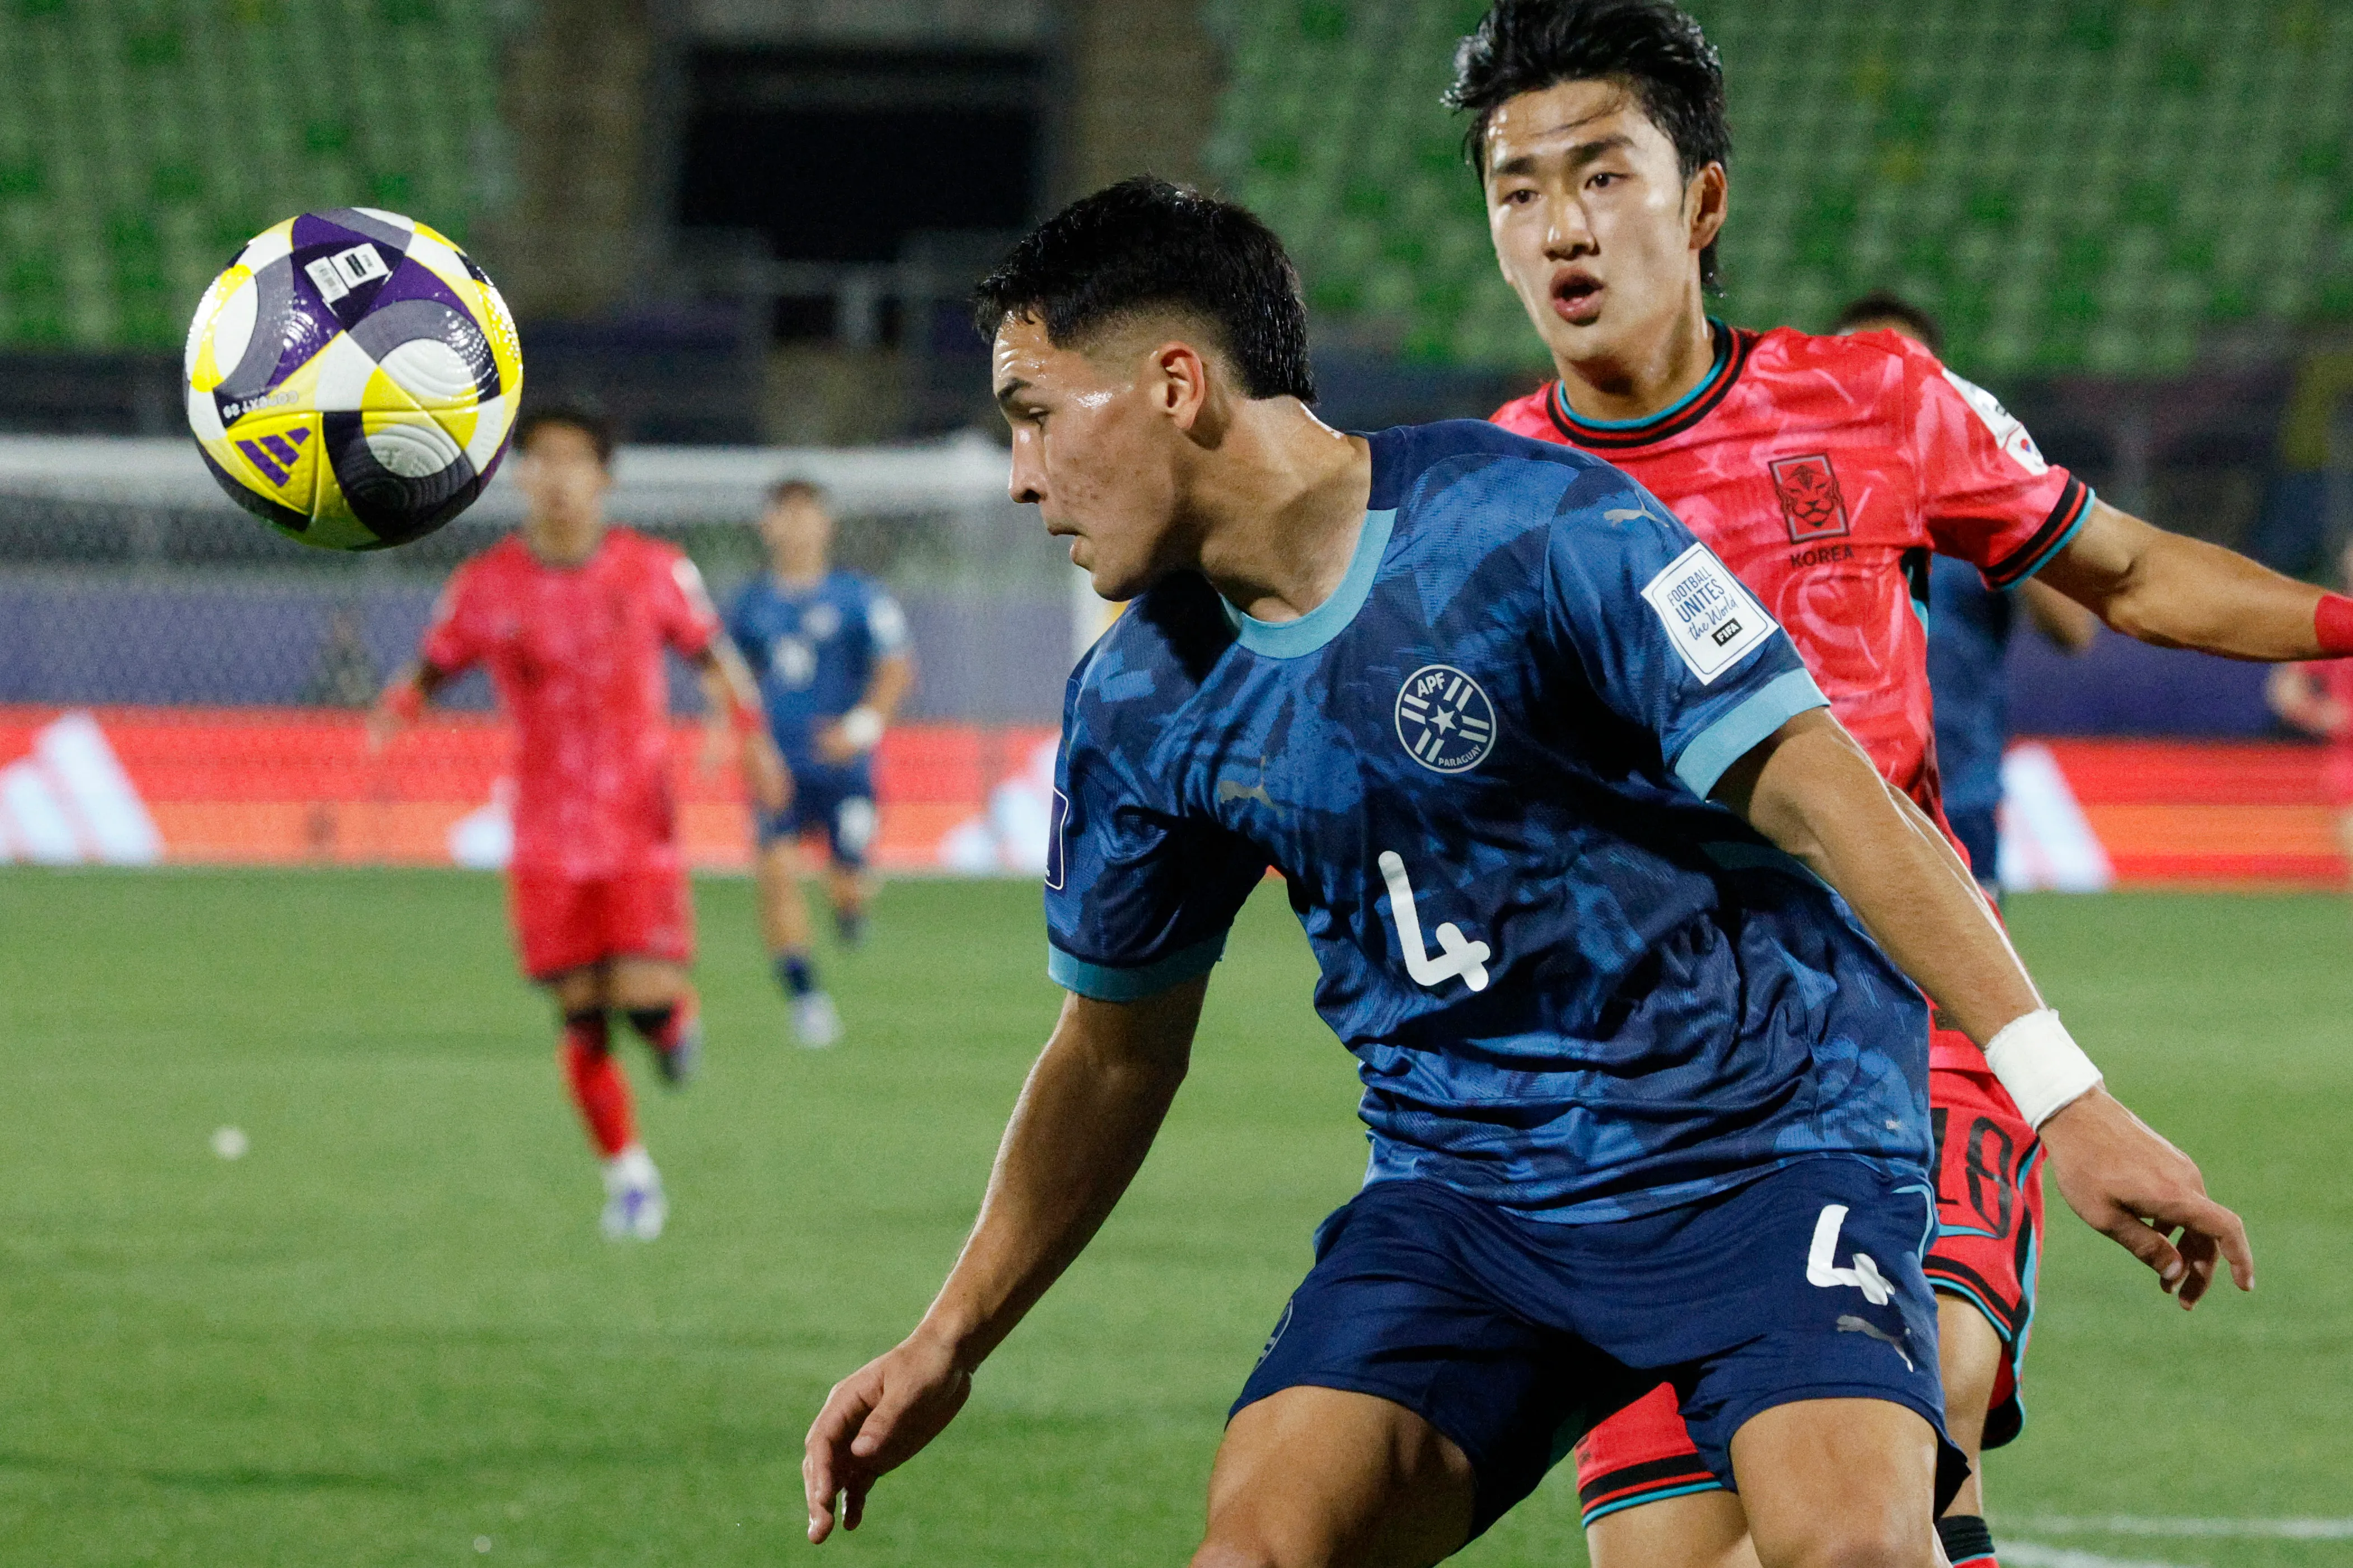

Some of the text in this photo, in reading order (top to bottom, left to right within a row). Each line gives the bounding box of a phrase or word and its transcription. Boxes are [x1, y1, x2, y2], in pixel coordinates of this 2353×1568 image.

[1789, 544, 1854, 567] KOREA
[1667, 566, 1712, 607] FOOTBALL
[1675, 579, 1725, 623] UNITES
[1688, 593, 1740, 641] the World
[1717, 623, 1740, 643] FIFA
[1417, 672, 1445, 697] APF
[1438, 744, 1482, 767] PARAGUAY
[1378, 851, 1490, 992] 4
[1806, 1204, 1895, 1306] 4
